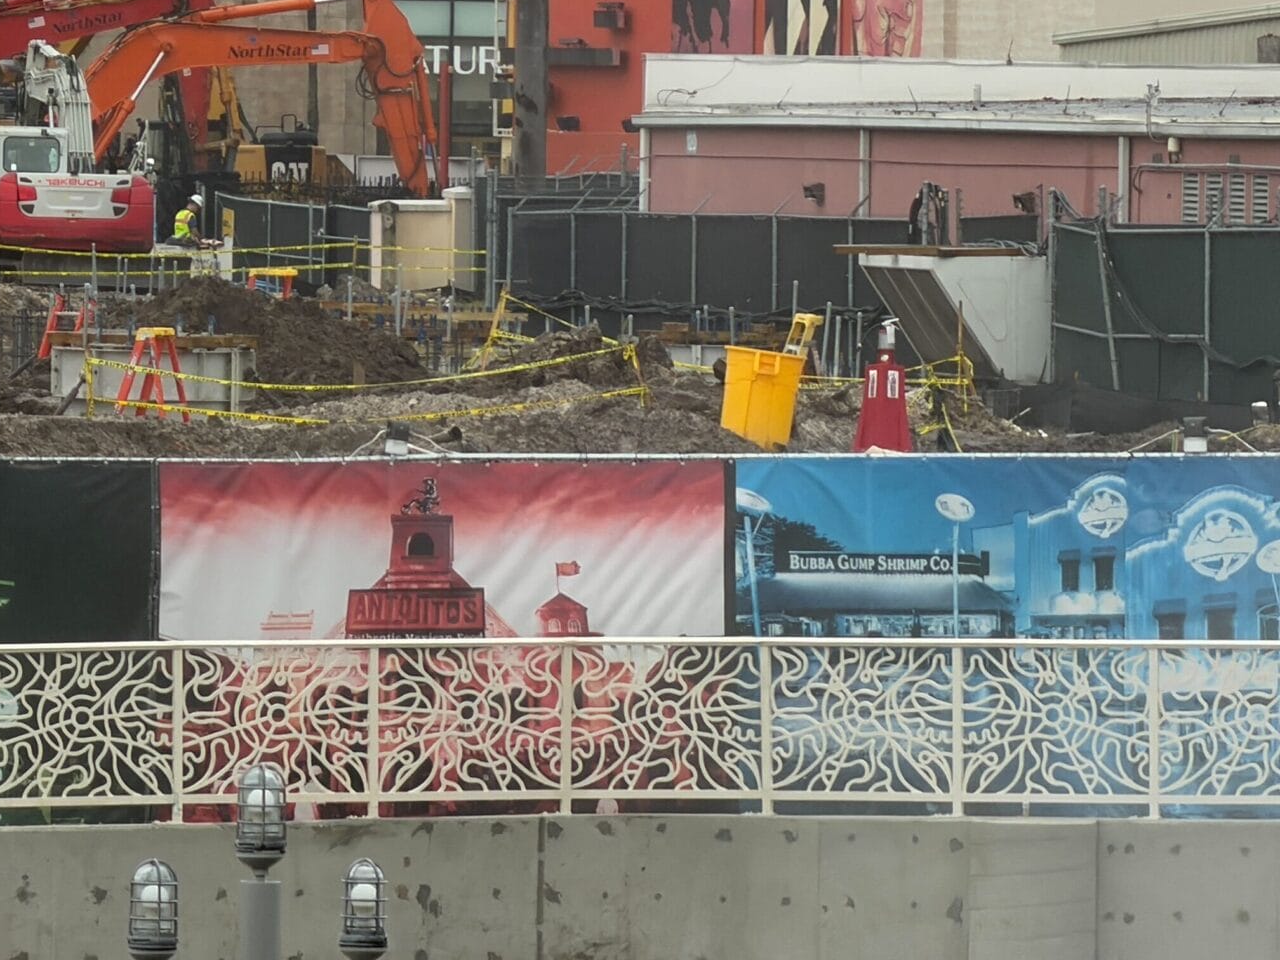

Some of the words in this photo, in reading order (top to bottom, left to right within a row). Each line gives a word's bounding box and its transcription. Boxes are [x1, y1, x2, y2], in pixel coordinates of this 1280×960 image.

[227, 43, 311, 60] NorthStar
[271, 161, 310, 184] CAT
[98, 360, 135, 371] CAUTION
[789, 554, 835, 570] BUBBA
[837, 554, 875, 571] GUMP
[877, 555, 928, 571] SHRIMP
